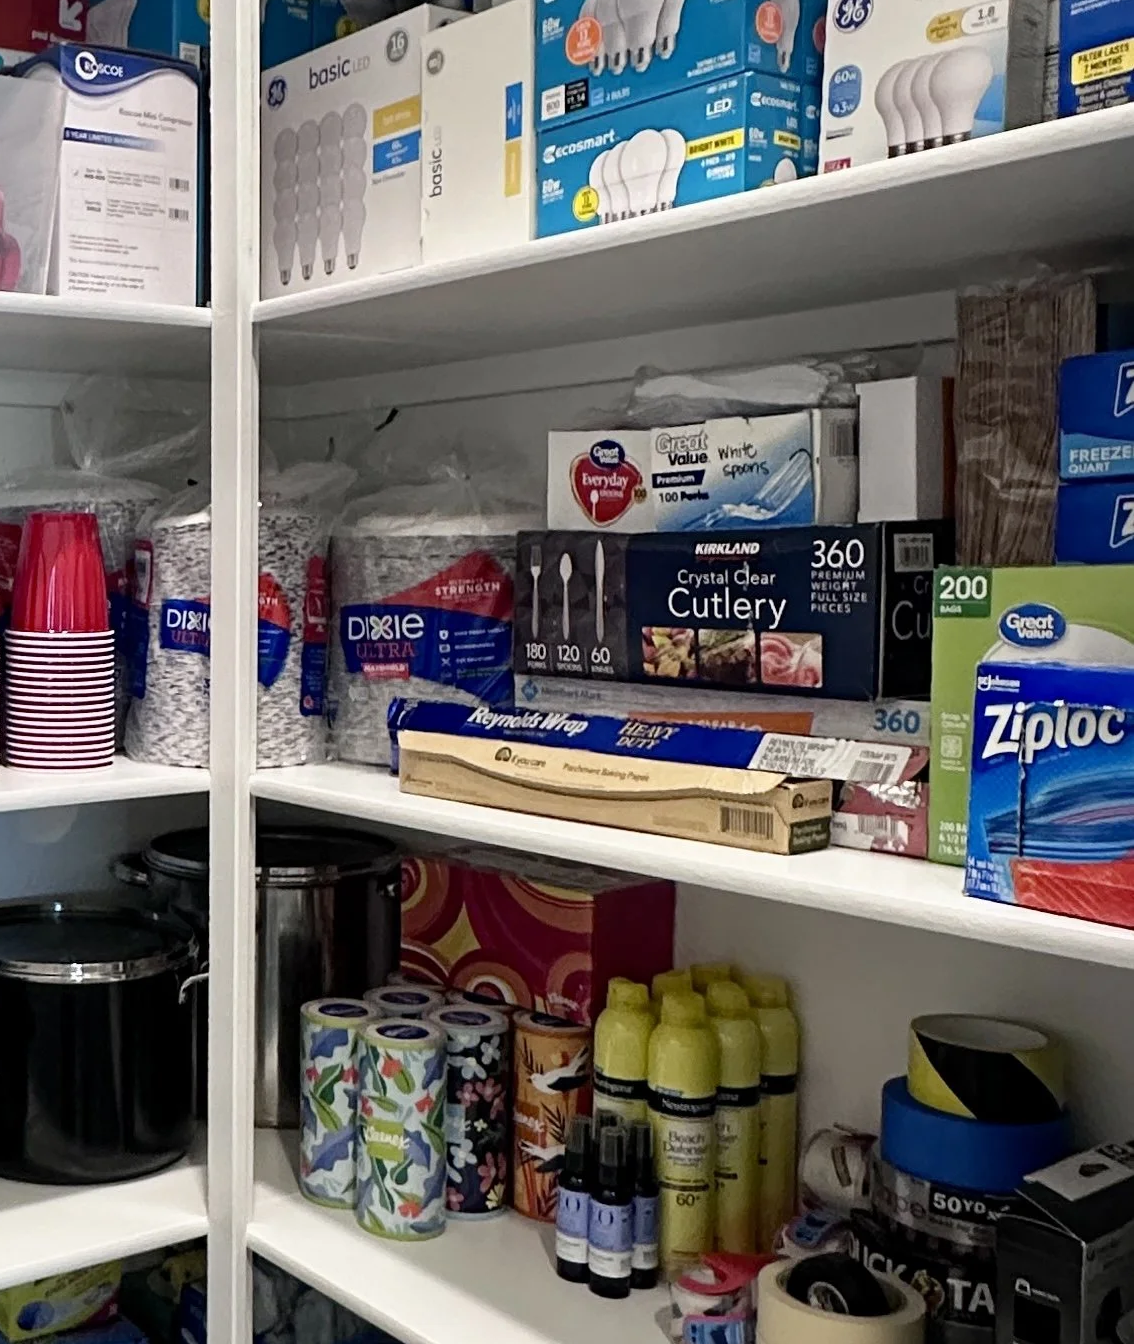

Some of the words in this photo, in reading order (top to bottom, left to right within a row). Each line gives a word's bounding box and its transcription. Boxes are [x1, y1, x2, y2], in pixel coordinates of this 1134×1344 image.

[977, 5, 996, 21] 1.8
[389, 33, 406, 52] 16
[1103, 42, 1130, 59] LASTS
[79, 56, 123, 78] ROSCOE
[308, 56, 351, 90] basic
[352, 56, 370, 74] LED
[833, 69, 857, 85] 60w
[705, 98, 733, 117] LED
[555, 127, 616, 158] ecosmart
[428, 148, 443, 199] basic
[655, 430, 709, 454] Great
[717, 441, 758, 460] White
[668, 451, 709, 467] Value
[1068, 461, 1111, 474] QUART
[656, 473, 695, 486] Premium
[721, 461, 771, 480] spoons
[582, 472, 629, 489] Everyday
[659, 491, 679, 503] 100
[694, 542, 761, 556] KIRKLAND
[810, 539, 865, 570] 360
[677, 569, 730, 587] Crystal
[732, 568, 777, 586] Clear
[810, 570, 867, 581] PREMIUM
[435, 581, 500, 597] STRENGTH
[810, 581, 857, 593] WEIGHT
[939, 575, 988, 601] 200
[810, 592, 839, 604] FULL
[841, 592, 868, 604] SIZE
[667, 587, 787, 630] Cutlery
[810, 603, 852, 614] PIECES
[939, 605, 963, 614] BAGS
[1005, 613, 1055, 631] Great
[1016, 627, 1055, 641] Value
[356, 641, 416, 658] ULTRA
[525, 642, 547, 660] 180
[557, 644, 580, 662] 120
[591, 646, 611, 664] 60
[467, 705, 544, 730] Reynolds
[541, 711, 589, 738] Wrap
[618, 721, 679, 740] HEAVY
[872, 709, 921, 734] 360
[981, 699, 1126, 764] Ziploc
[616, 736, 659, 750] DUTY
[601, 767, 627, 780] Baking
